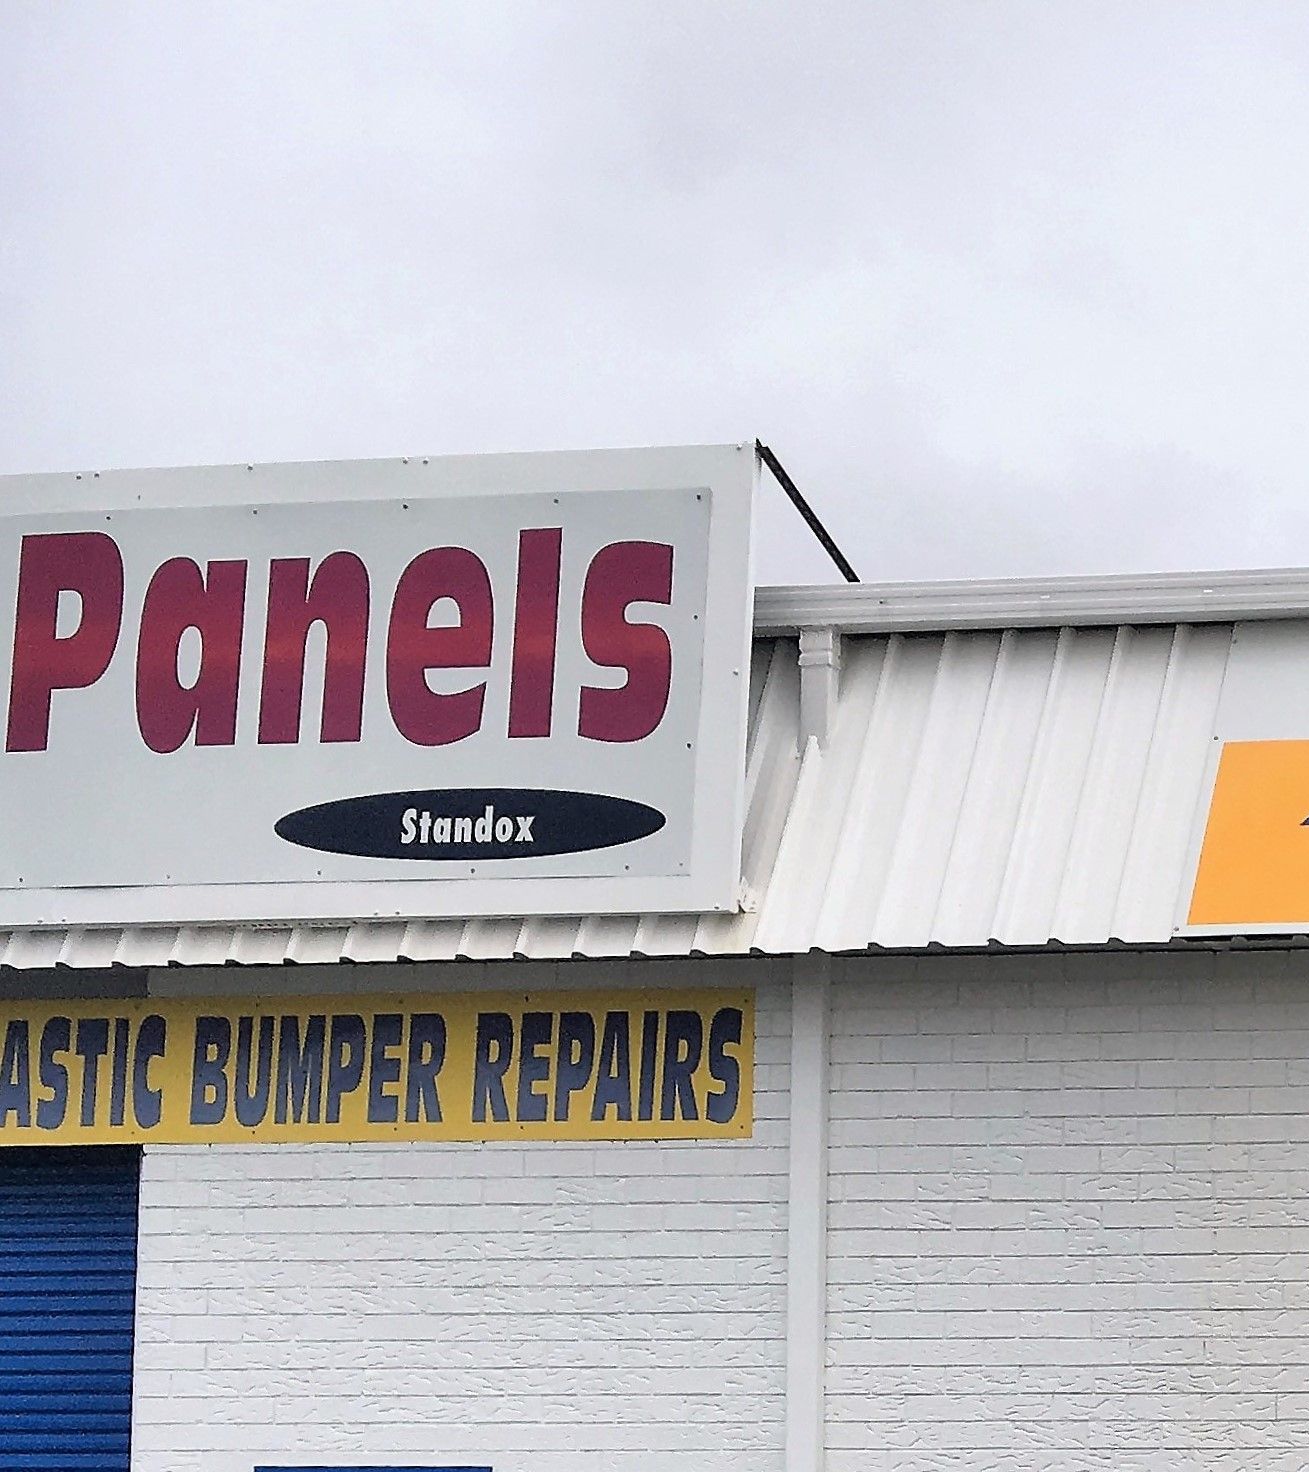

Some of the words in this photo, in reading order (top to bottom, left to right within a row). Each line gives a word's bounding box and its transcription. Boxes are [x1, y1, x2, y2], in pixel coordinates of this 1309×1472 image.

[5, 528, 674, 754] Panels
[400, 806, 535, 845] Standox
[0, 1014, 166, 1130] ASTIC
[190, 1012, 447, 1128] BUMPER
[472, 1007, 743, 1124] REPAIRS
